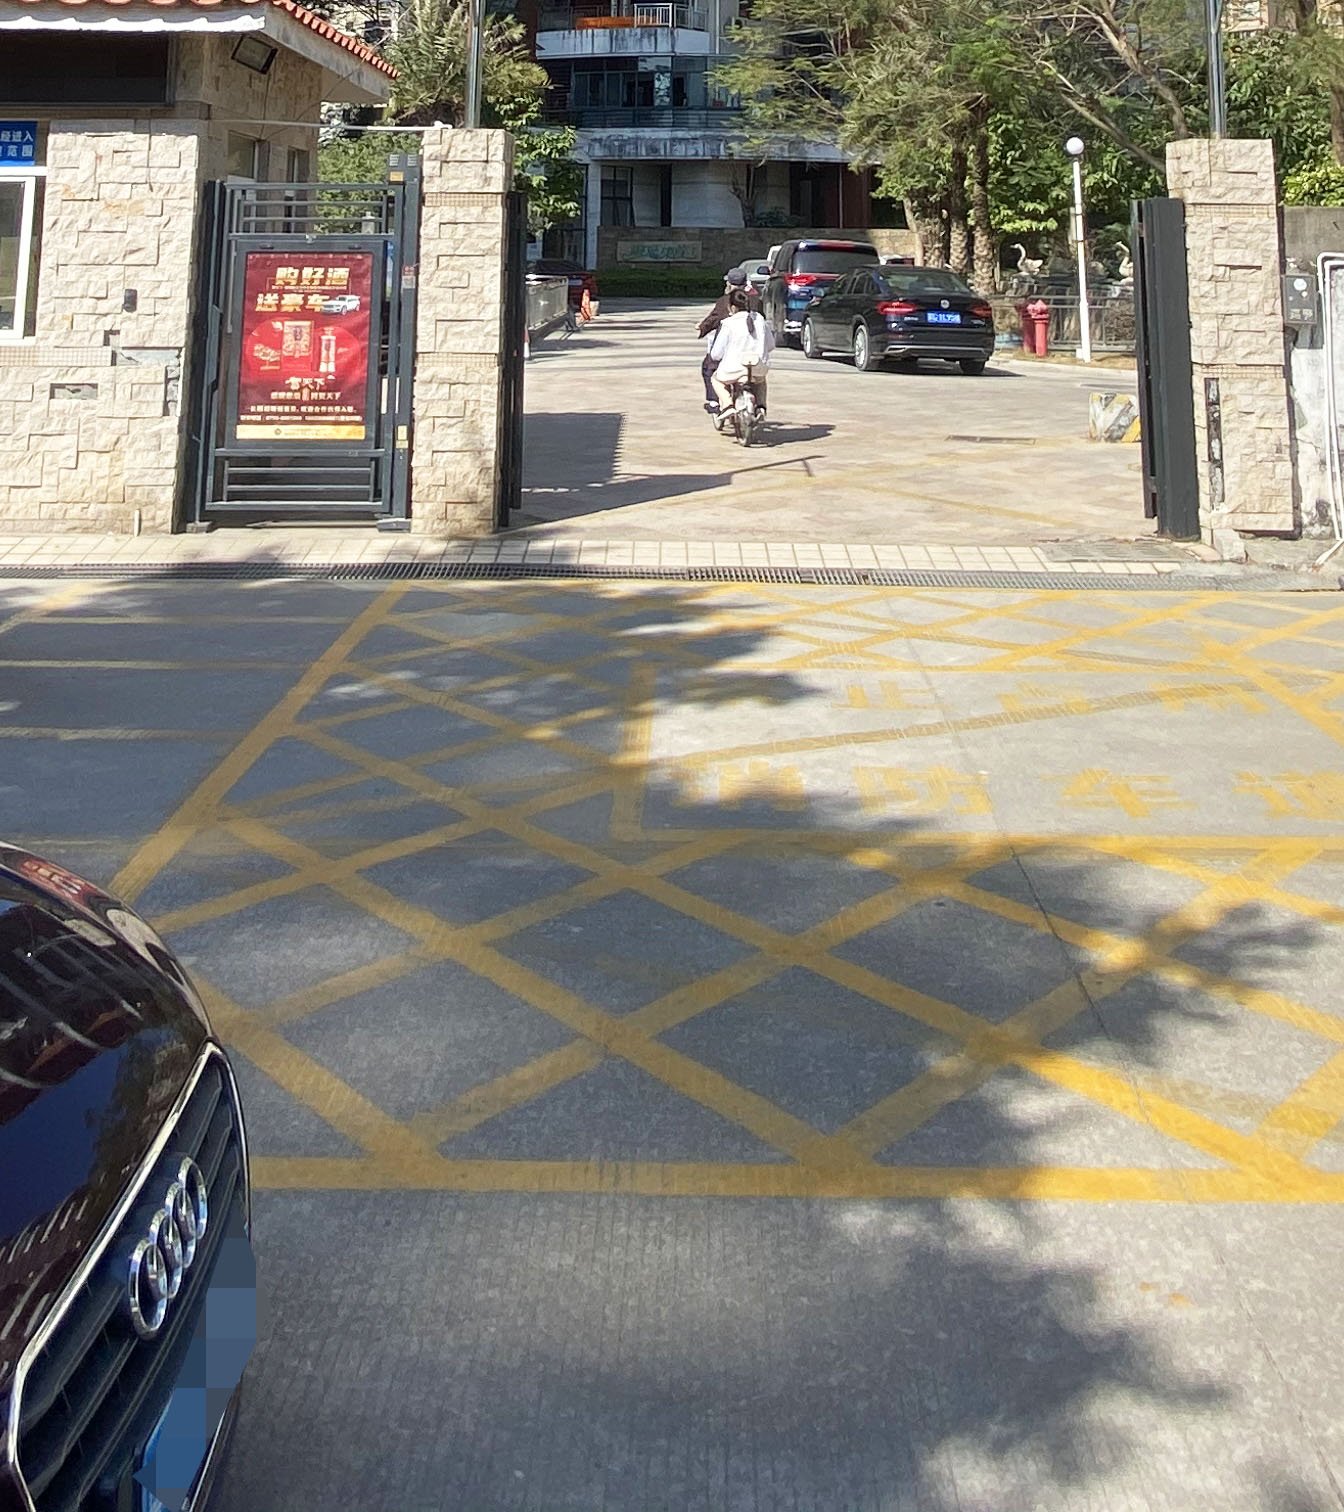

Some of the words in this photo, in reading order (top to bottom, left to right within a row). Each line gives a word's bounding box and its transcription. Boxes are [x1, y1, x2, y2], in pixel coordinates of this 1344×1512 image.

[275, 267, 350, 286] 购好酒
[255, 293, 330, 312] 送豪车
